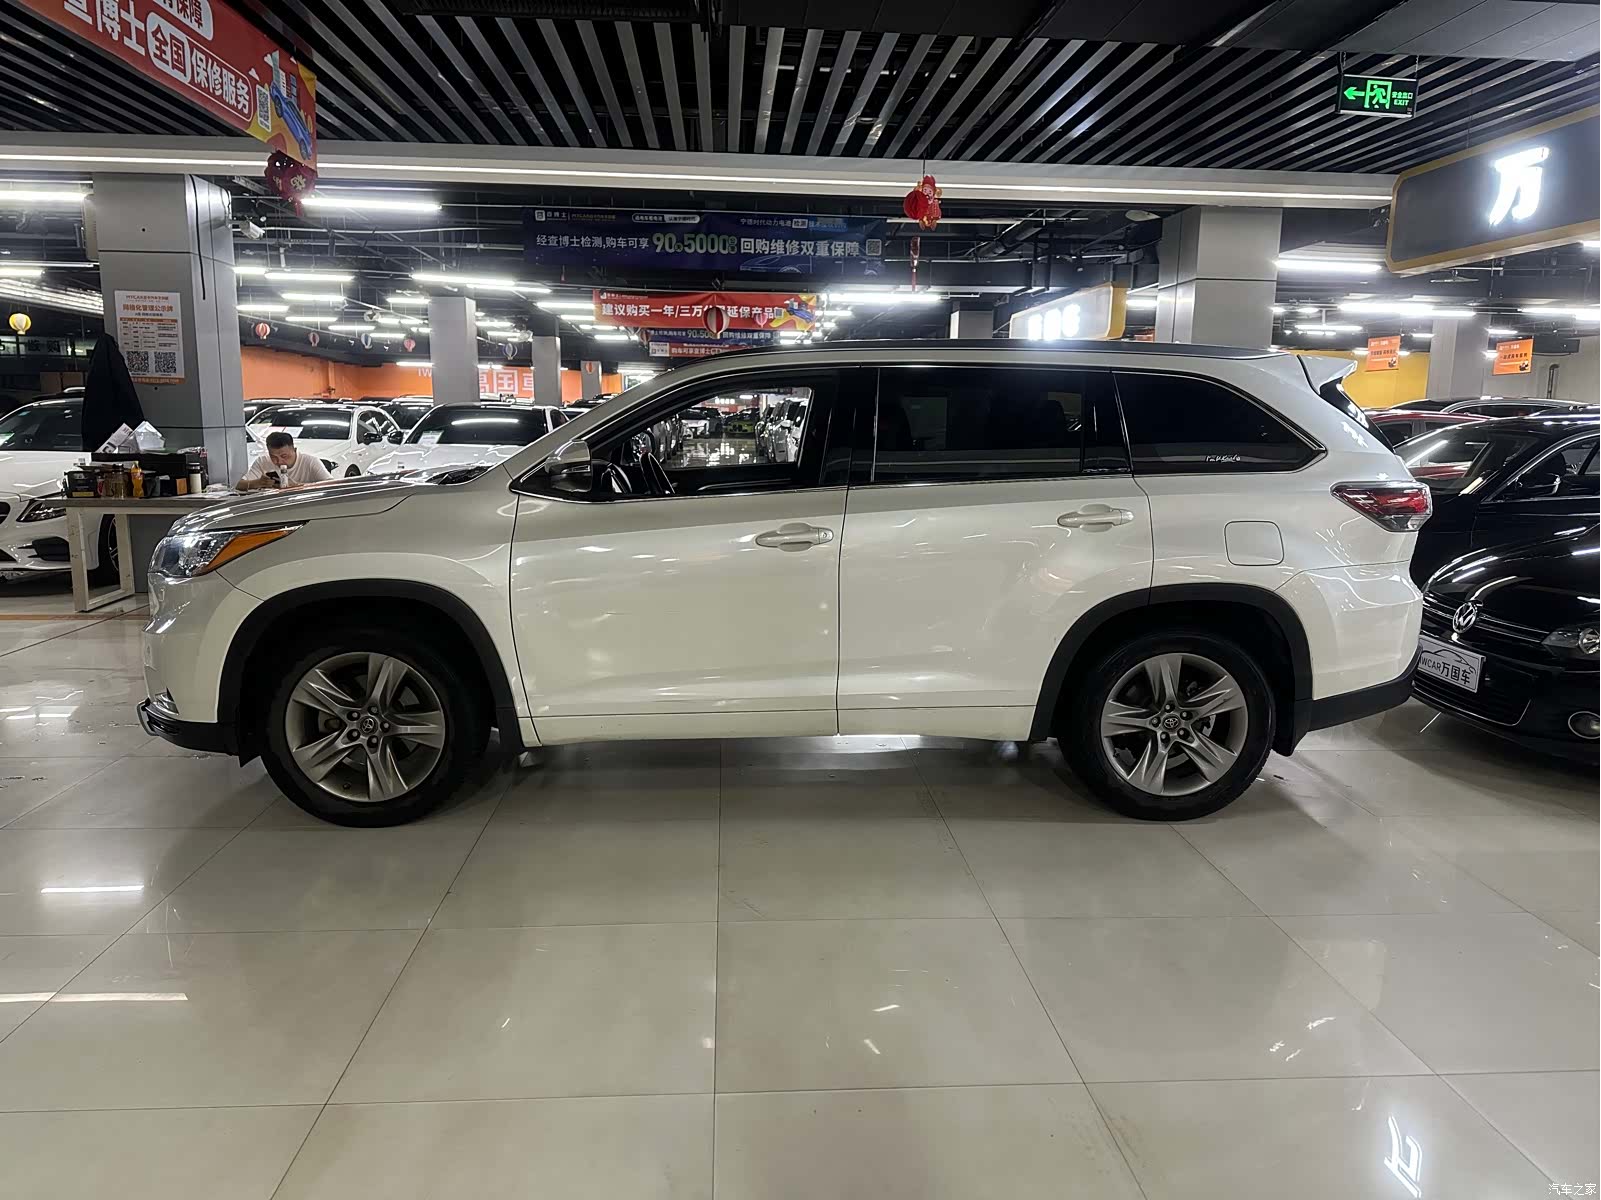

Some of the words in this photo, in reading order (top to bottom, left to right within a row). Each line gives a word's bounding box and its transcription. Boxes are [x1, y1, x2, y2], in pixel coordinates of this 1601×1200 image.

[1489, 146, 1550, 227] 万
[536, 234, 649, 249] 经查博士检测,购车可享
[740, 237, 860, 257] 回购维修双重保障
[602, 303, 774, 319] 建议购买一年/三万延保产品
